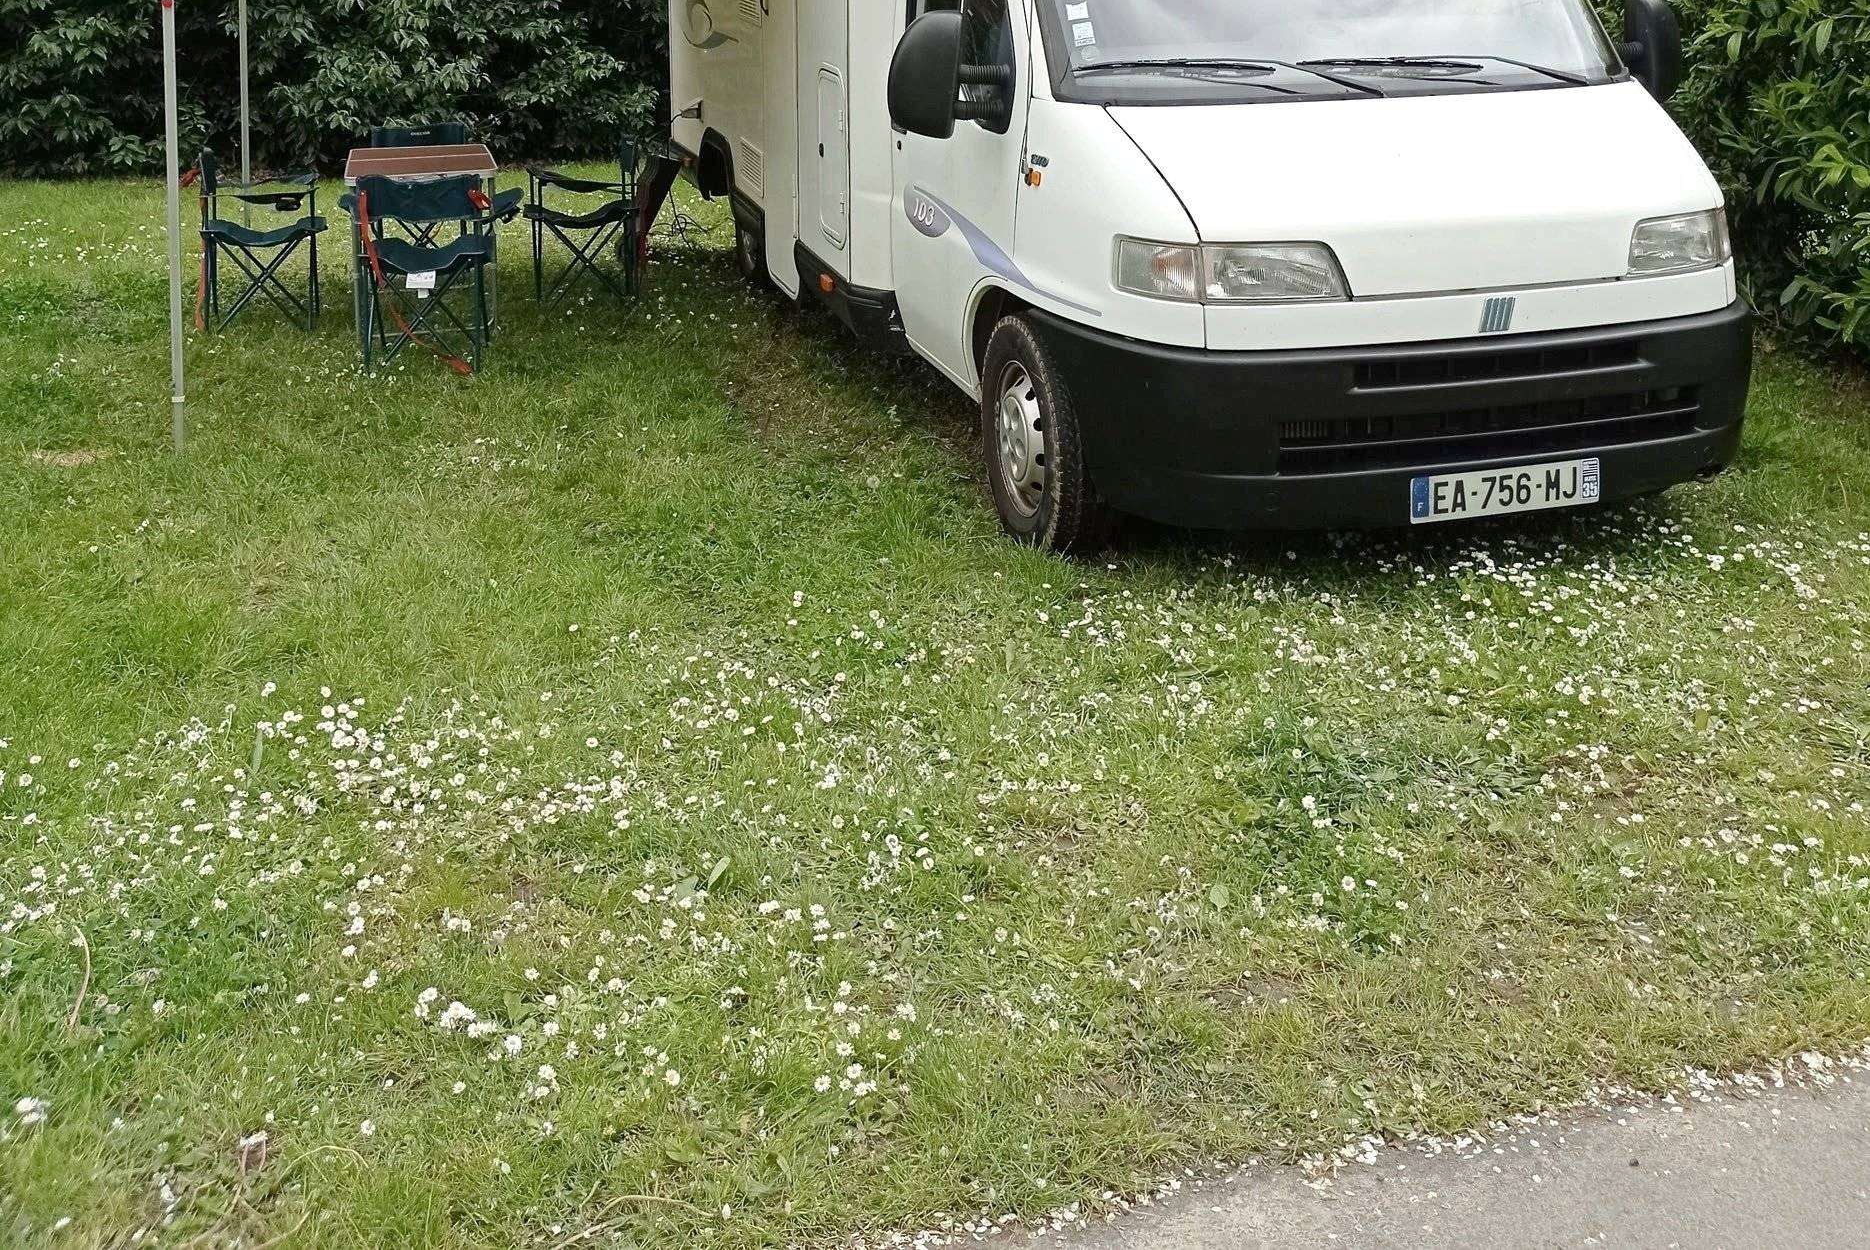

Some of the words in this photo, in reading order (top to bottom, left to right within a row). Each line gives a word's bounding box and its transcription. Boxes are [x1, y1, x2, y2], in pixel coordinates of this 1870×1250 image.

[913, 198, 935, 226] 103
[1433, 466, 1578, 515] EA-756-MJ
[1582, 481, 1598, 498] 35
[1417, 502, 1424, 513] F
